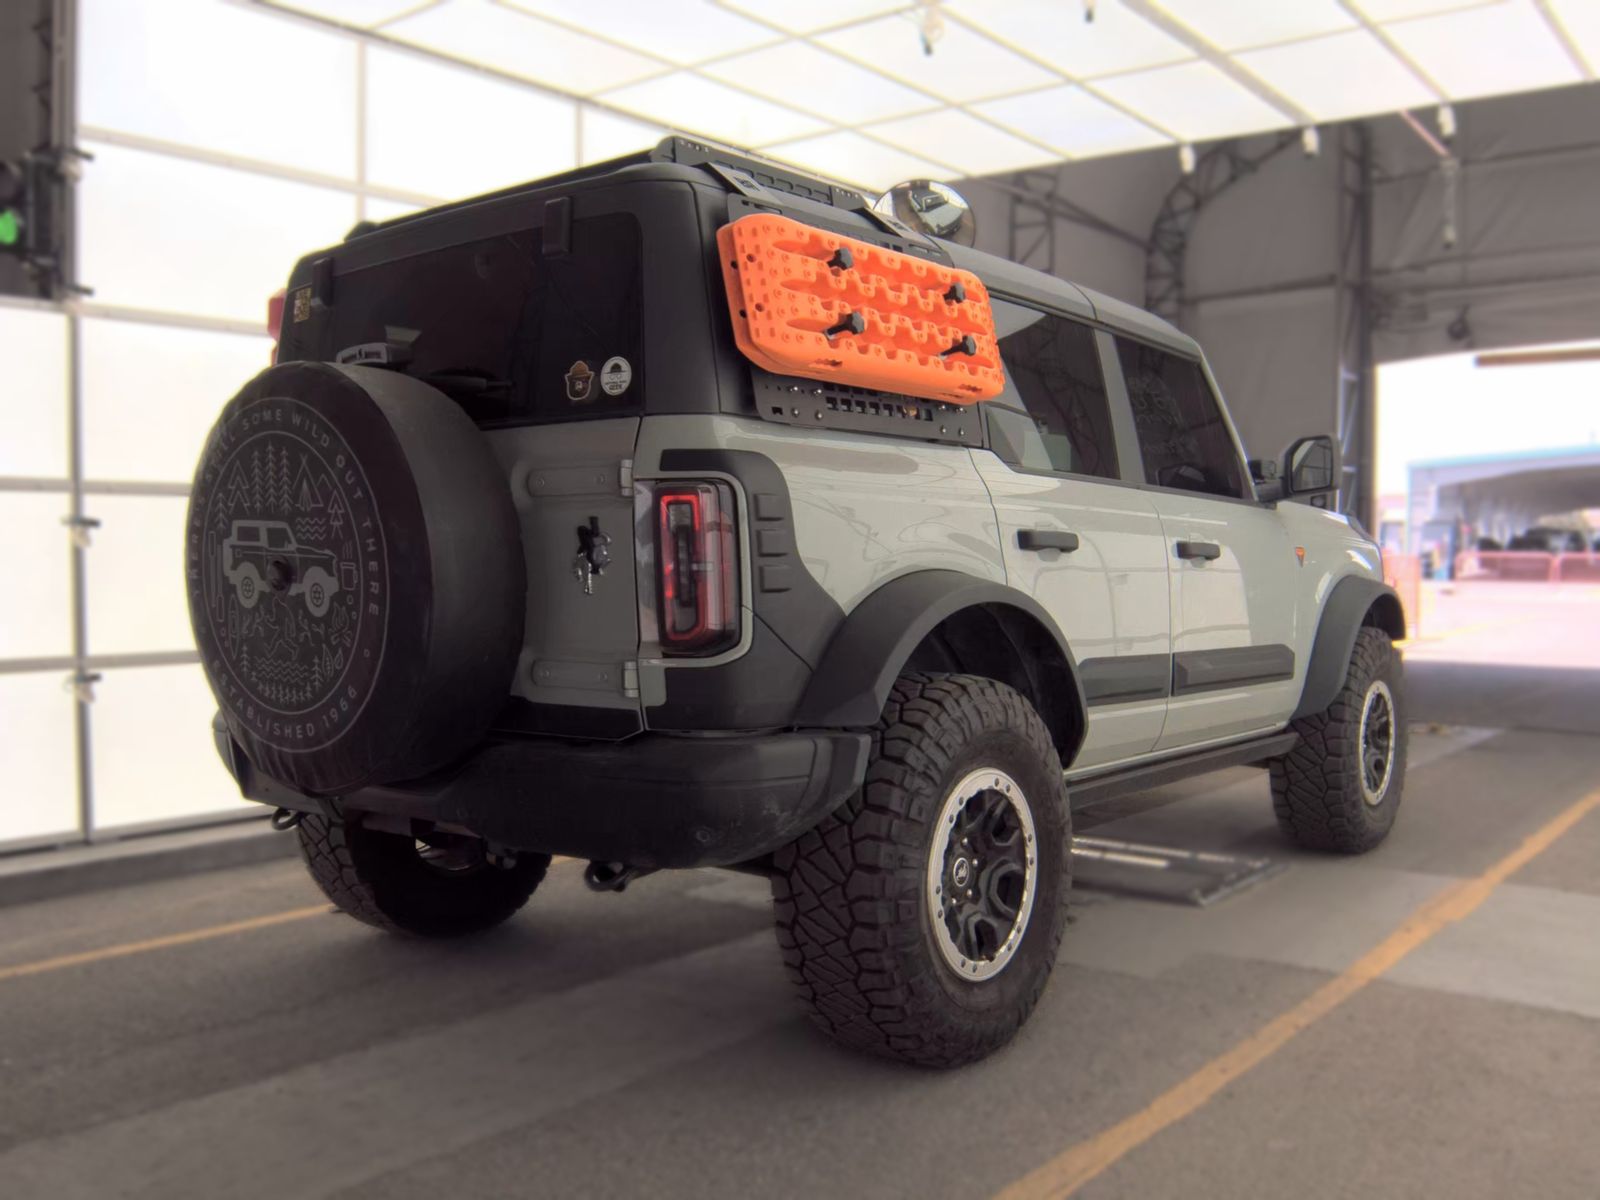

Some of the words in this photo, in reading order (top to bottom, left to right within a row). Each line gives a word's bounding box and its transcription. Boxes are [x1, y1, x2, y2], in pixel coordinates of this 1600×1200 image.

[242, 409, 282, 431] SOME
[291, 411, 331, 448] WILD
[336, 454, 363, 500] OUT
[361, 518, 380, 616] THERE
[213, 660, 316, 739] ESTABLISHED
[322, 684, 358, 729] 1966
